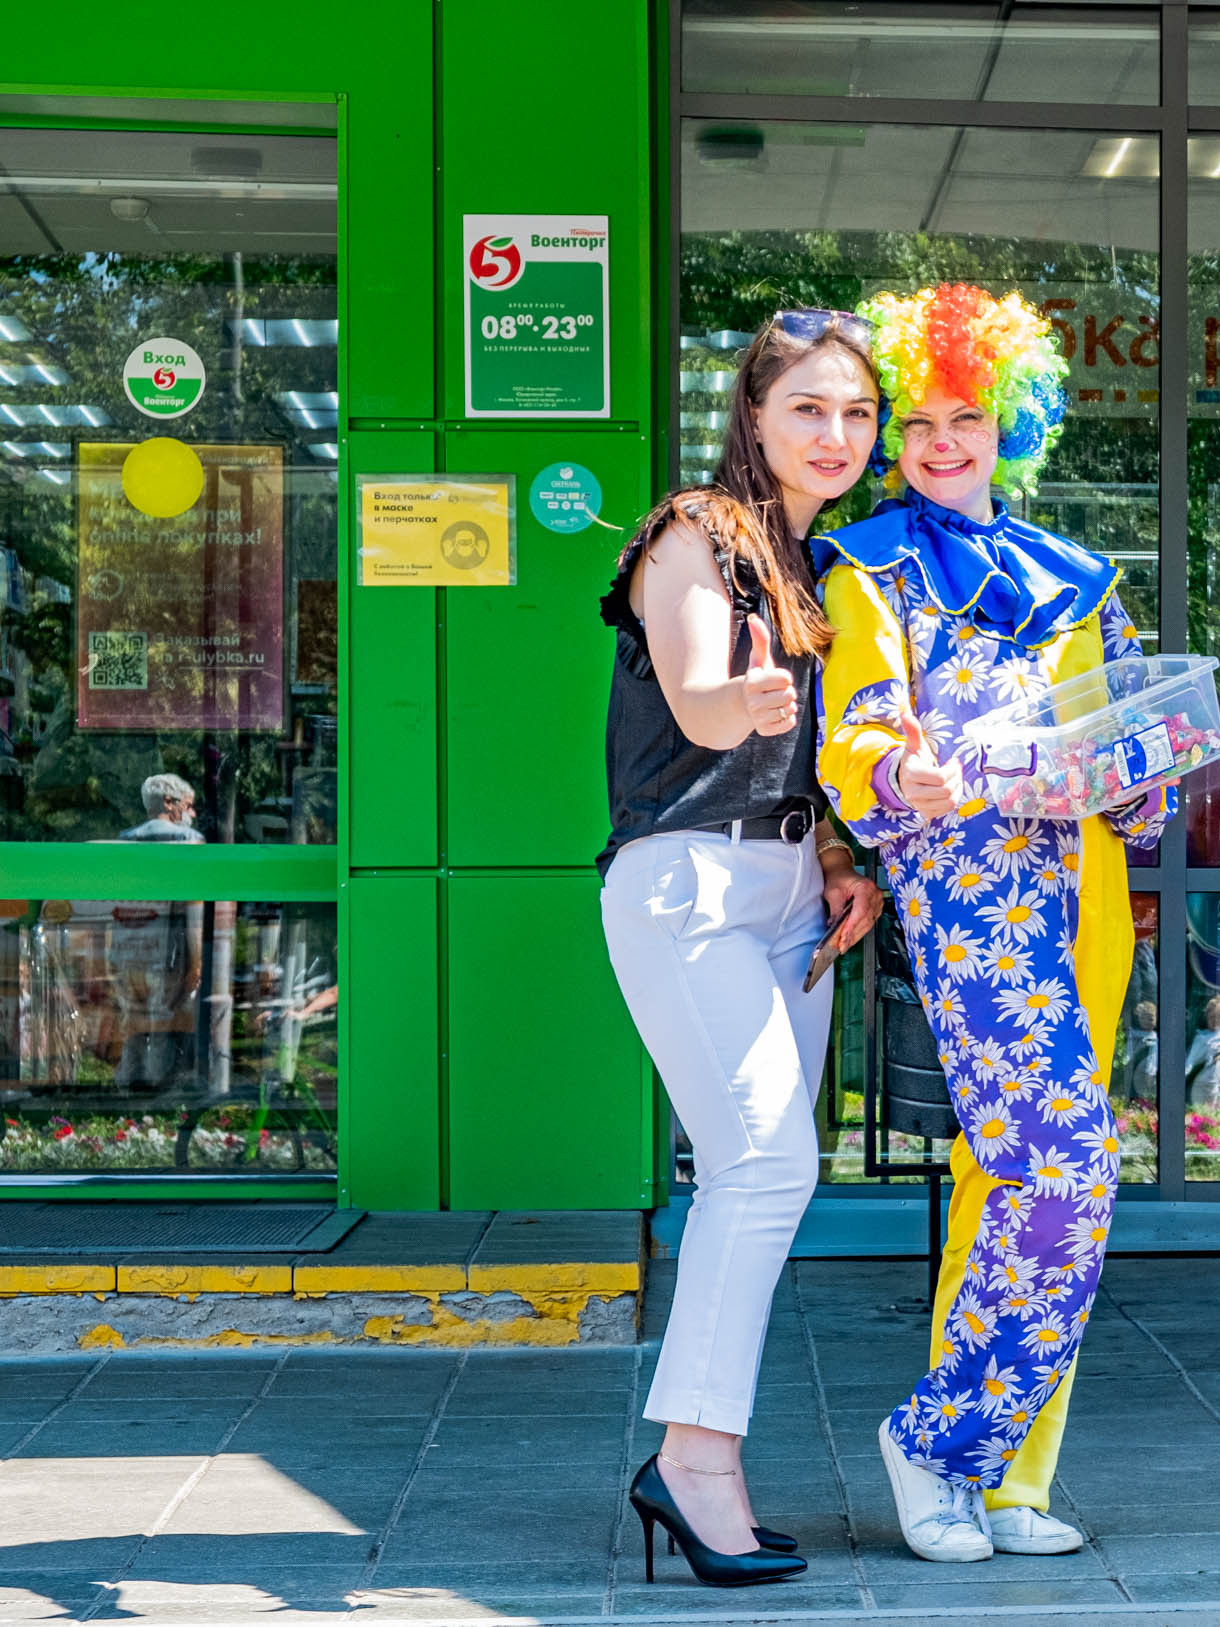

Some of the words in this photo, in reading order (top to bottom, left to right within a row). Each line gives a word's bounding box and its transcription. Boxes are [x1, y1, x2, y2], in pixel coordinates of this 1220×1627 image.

[531, 234, 606, 251] Военторг
[143, 351, 186, 367] Вход
[374, 491, 400, 502] Вход
[382, 503, 414, 511] маске
[383, 516, 438, 525] перчатках
[178, 649, 265, 666] r-ulybka.ru
